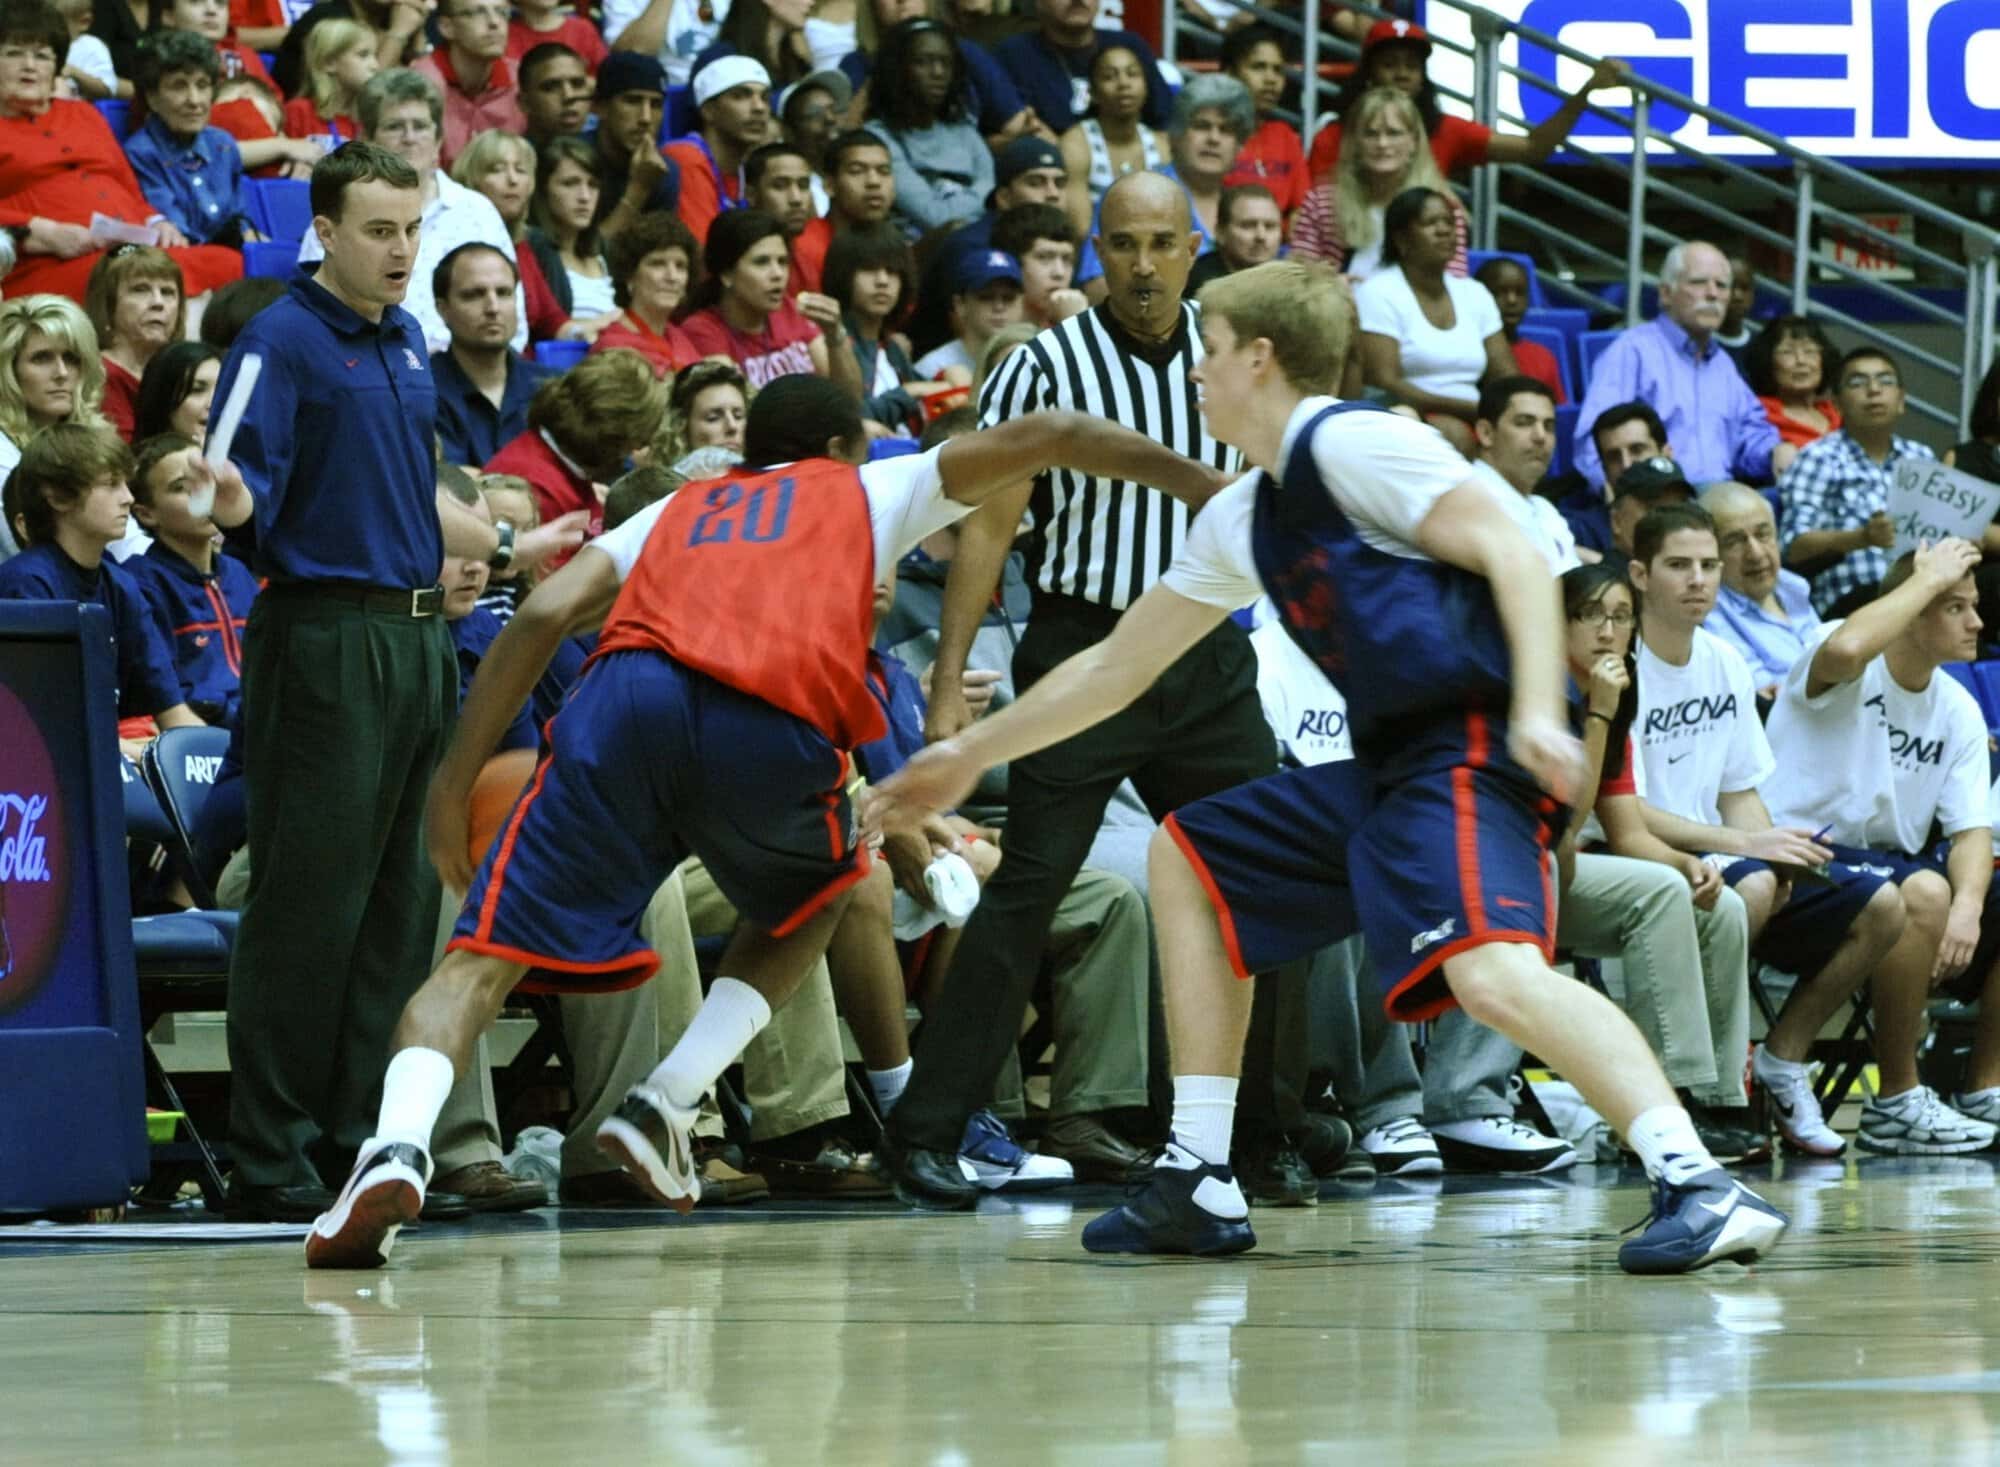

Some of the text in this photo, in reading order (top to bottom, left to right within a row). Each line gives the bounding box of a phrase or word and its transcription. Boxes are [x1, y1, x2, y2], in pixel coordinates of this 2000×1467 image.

[686, 477, 796, 549] 20
[1921, 468, 1986, 519] Easy
[1644, 693, 1737, 736] RIZONA
